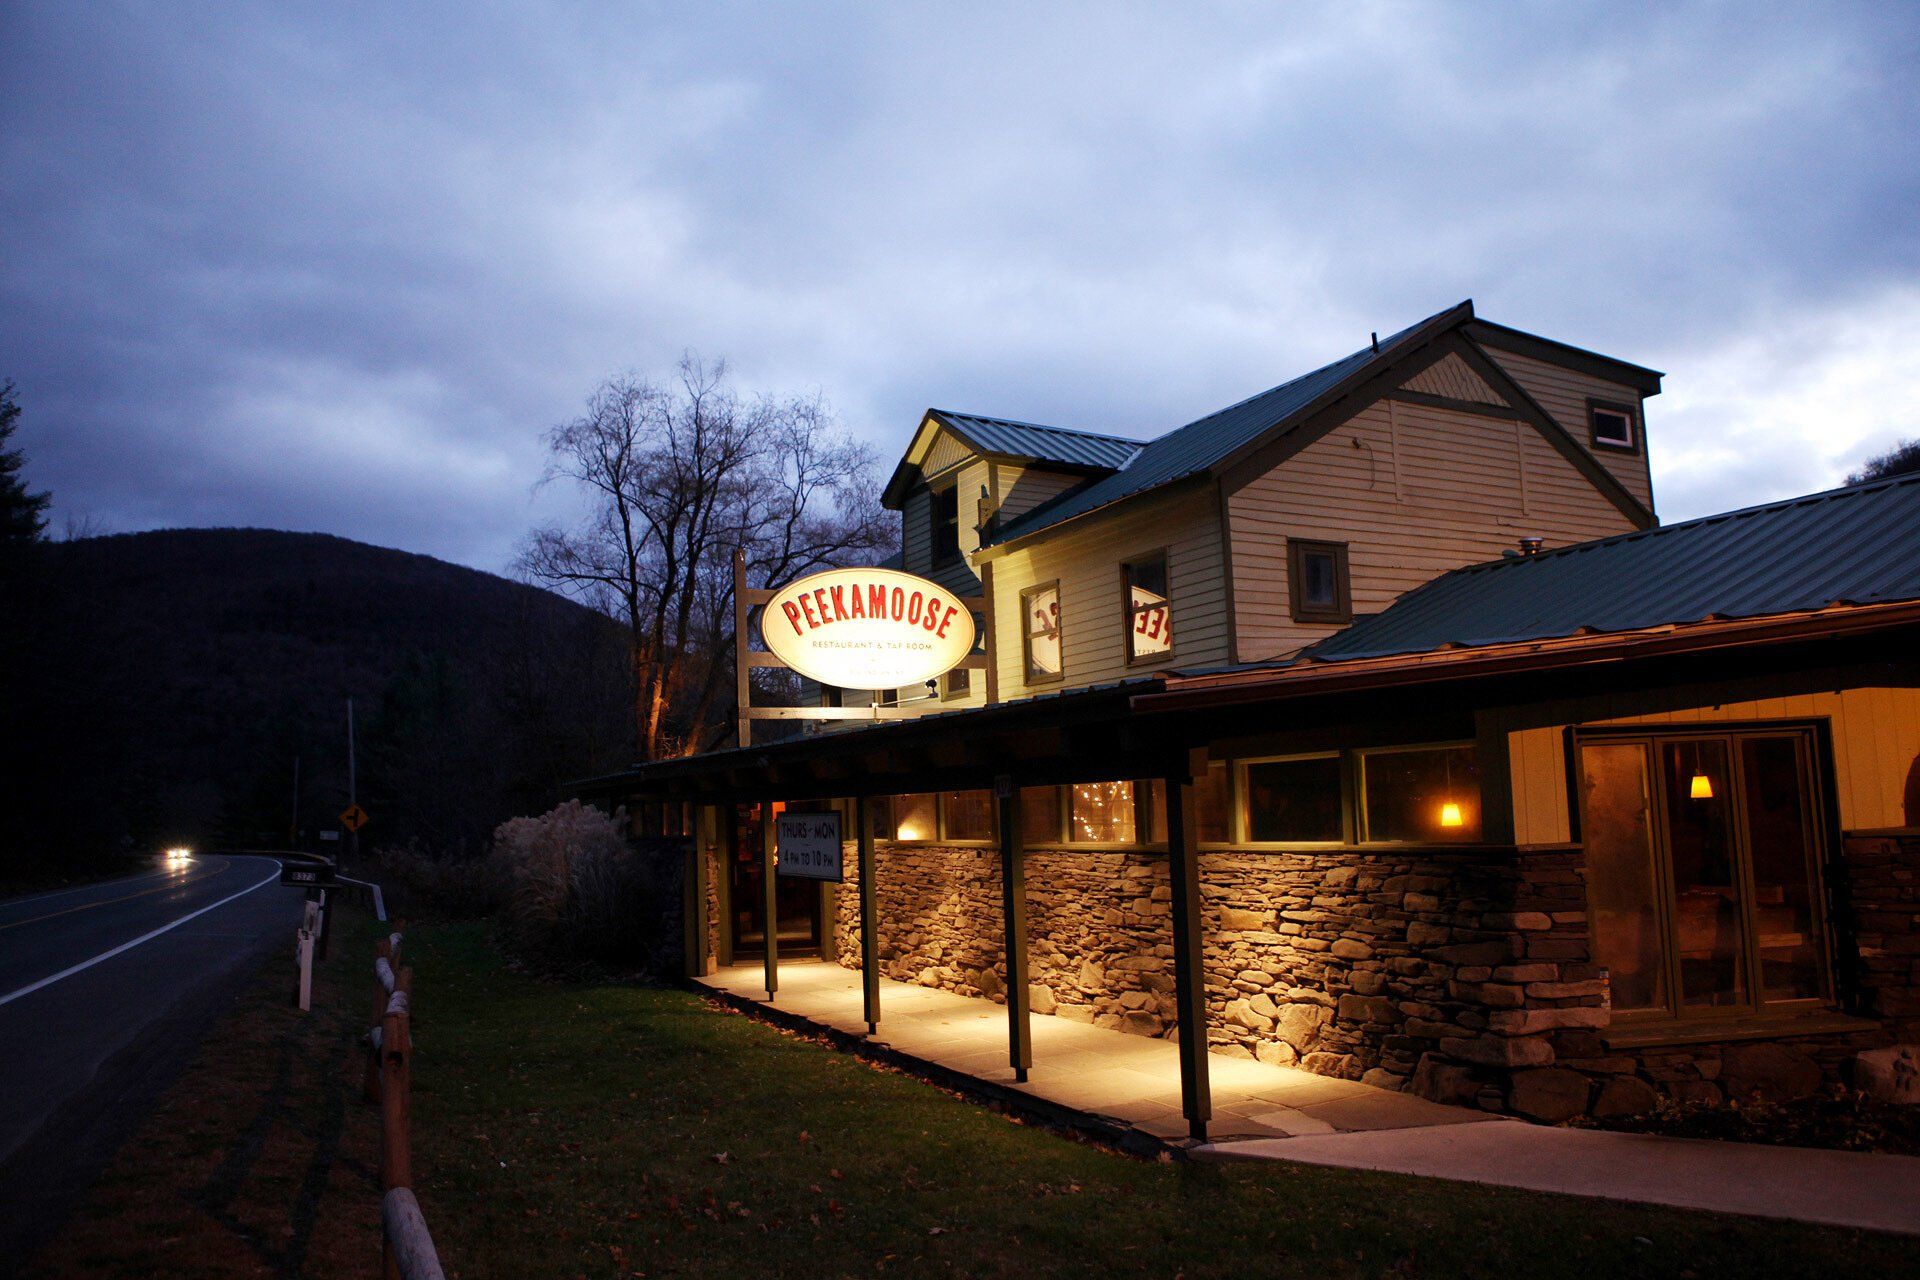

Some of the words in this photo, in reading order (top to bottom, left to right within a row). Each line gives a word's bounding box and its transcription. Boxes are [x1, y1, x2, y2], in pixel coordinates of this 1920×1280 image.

[781, 584, 958, 639] PEEKAMOOSE
[812, 641, 873, 649] RESTAURANT
[783, 849, 789, 864] 4
[801, 852, 810, 865] TO
[812, 850, 821, 866] 10
